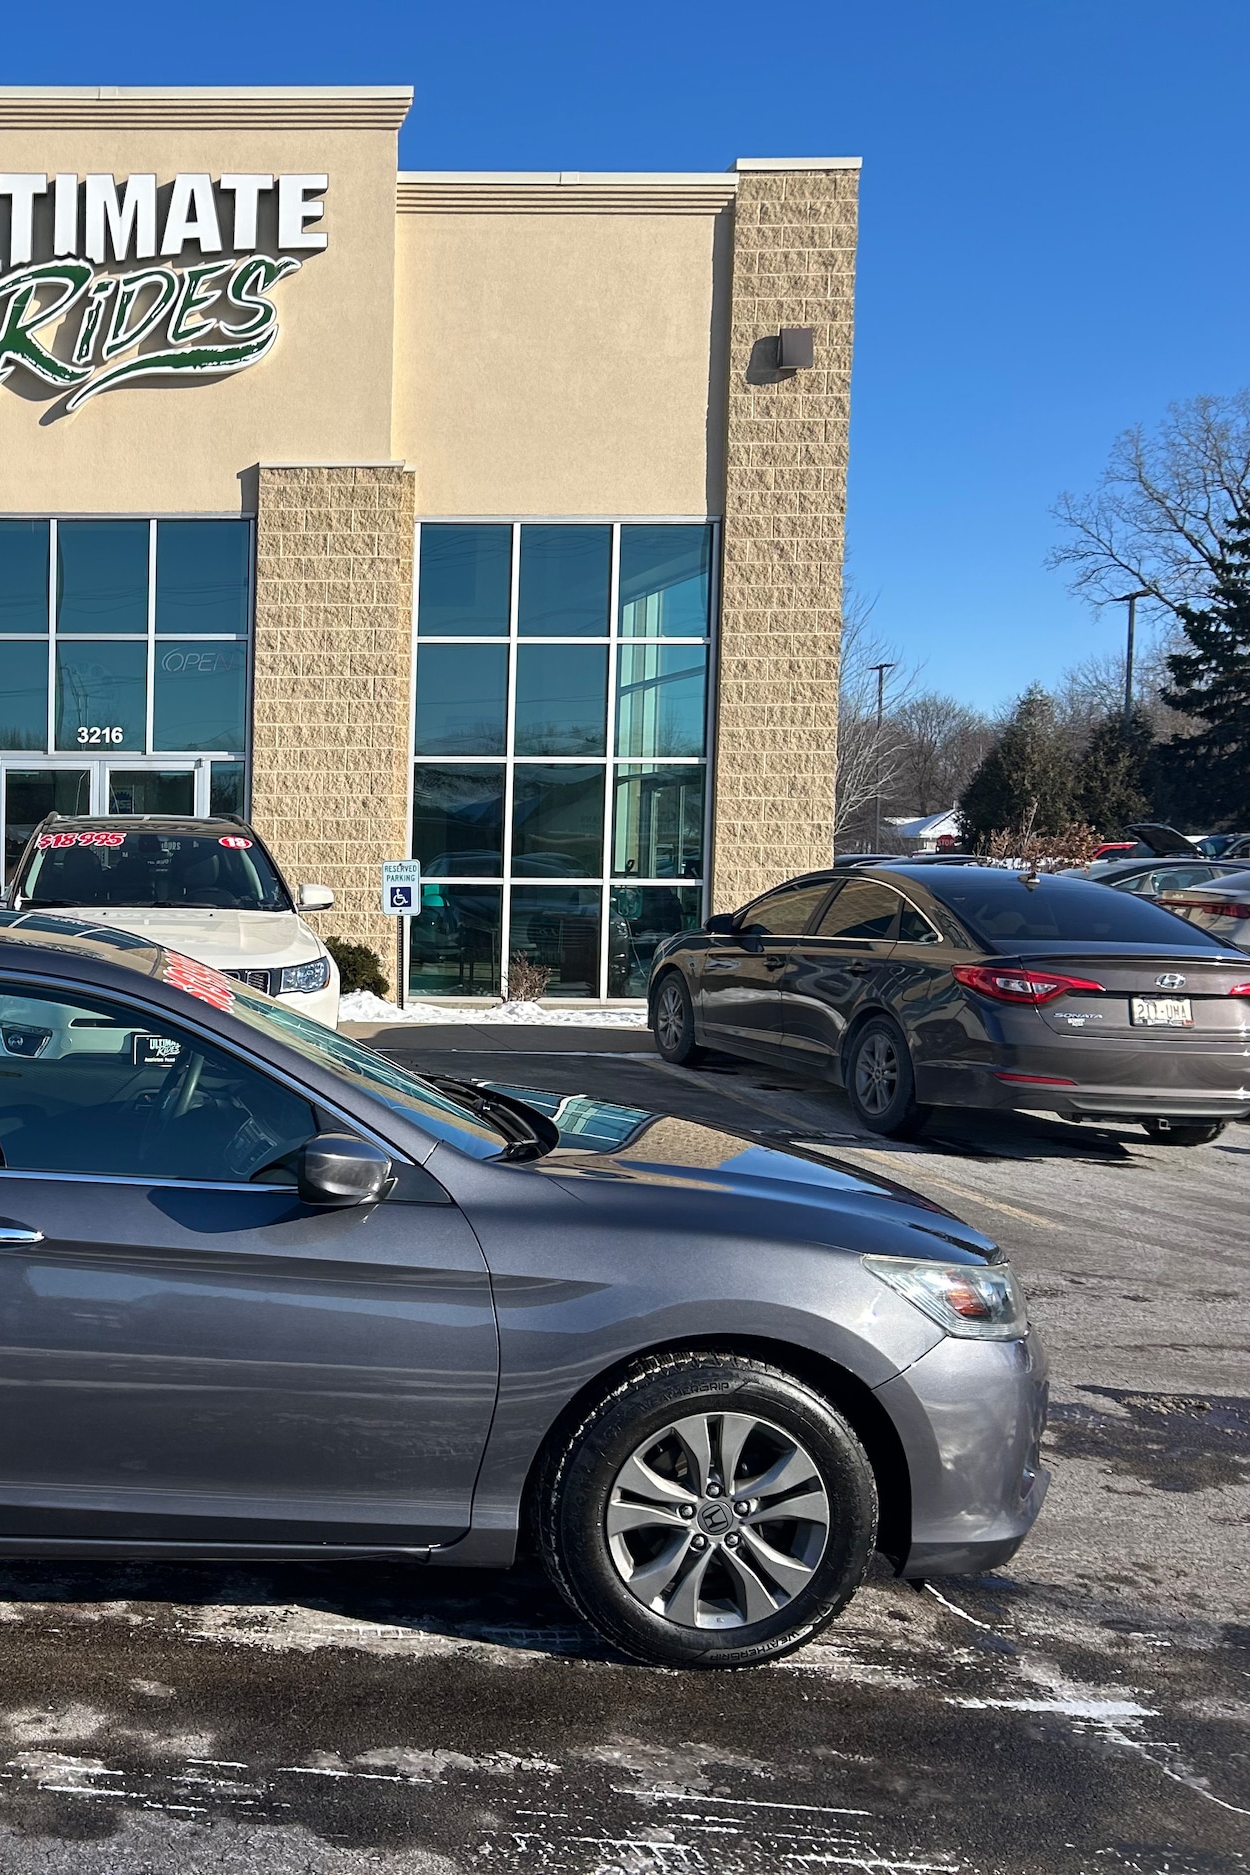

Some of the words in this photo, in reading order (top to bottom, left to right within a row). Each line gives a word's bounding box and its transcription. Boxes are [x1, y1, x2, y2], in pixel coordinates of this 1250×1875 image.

[163, 651, 235, 673] OPEN
[76, 726, 124, 744] 3216
[937, 838, 955, 847] STOP
[384, 864, 418, 873] RESERVED
[386, 874, 416, 882] PARKING
[1053, 1011, 1103, 1019] SONATA
[710, 1630, 801, 1660] WEATHERGRIP
